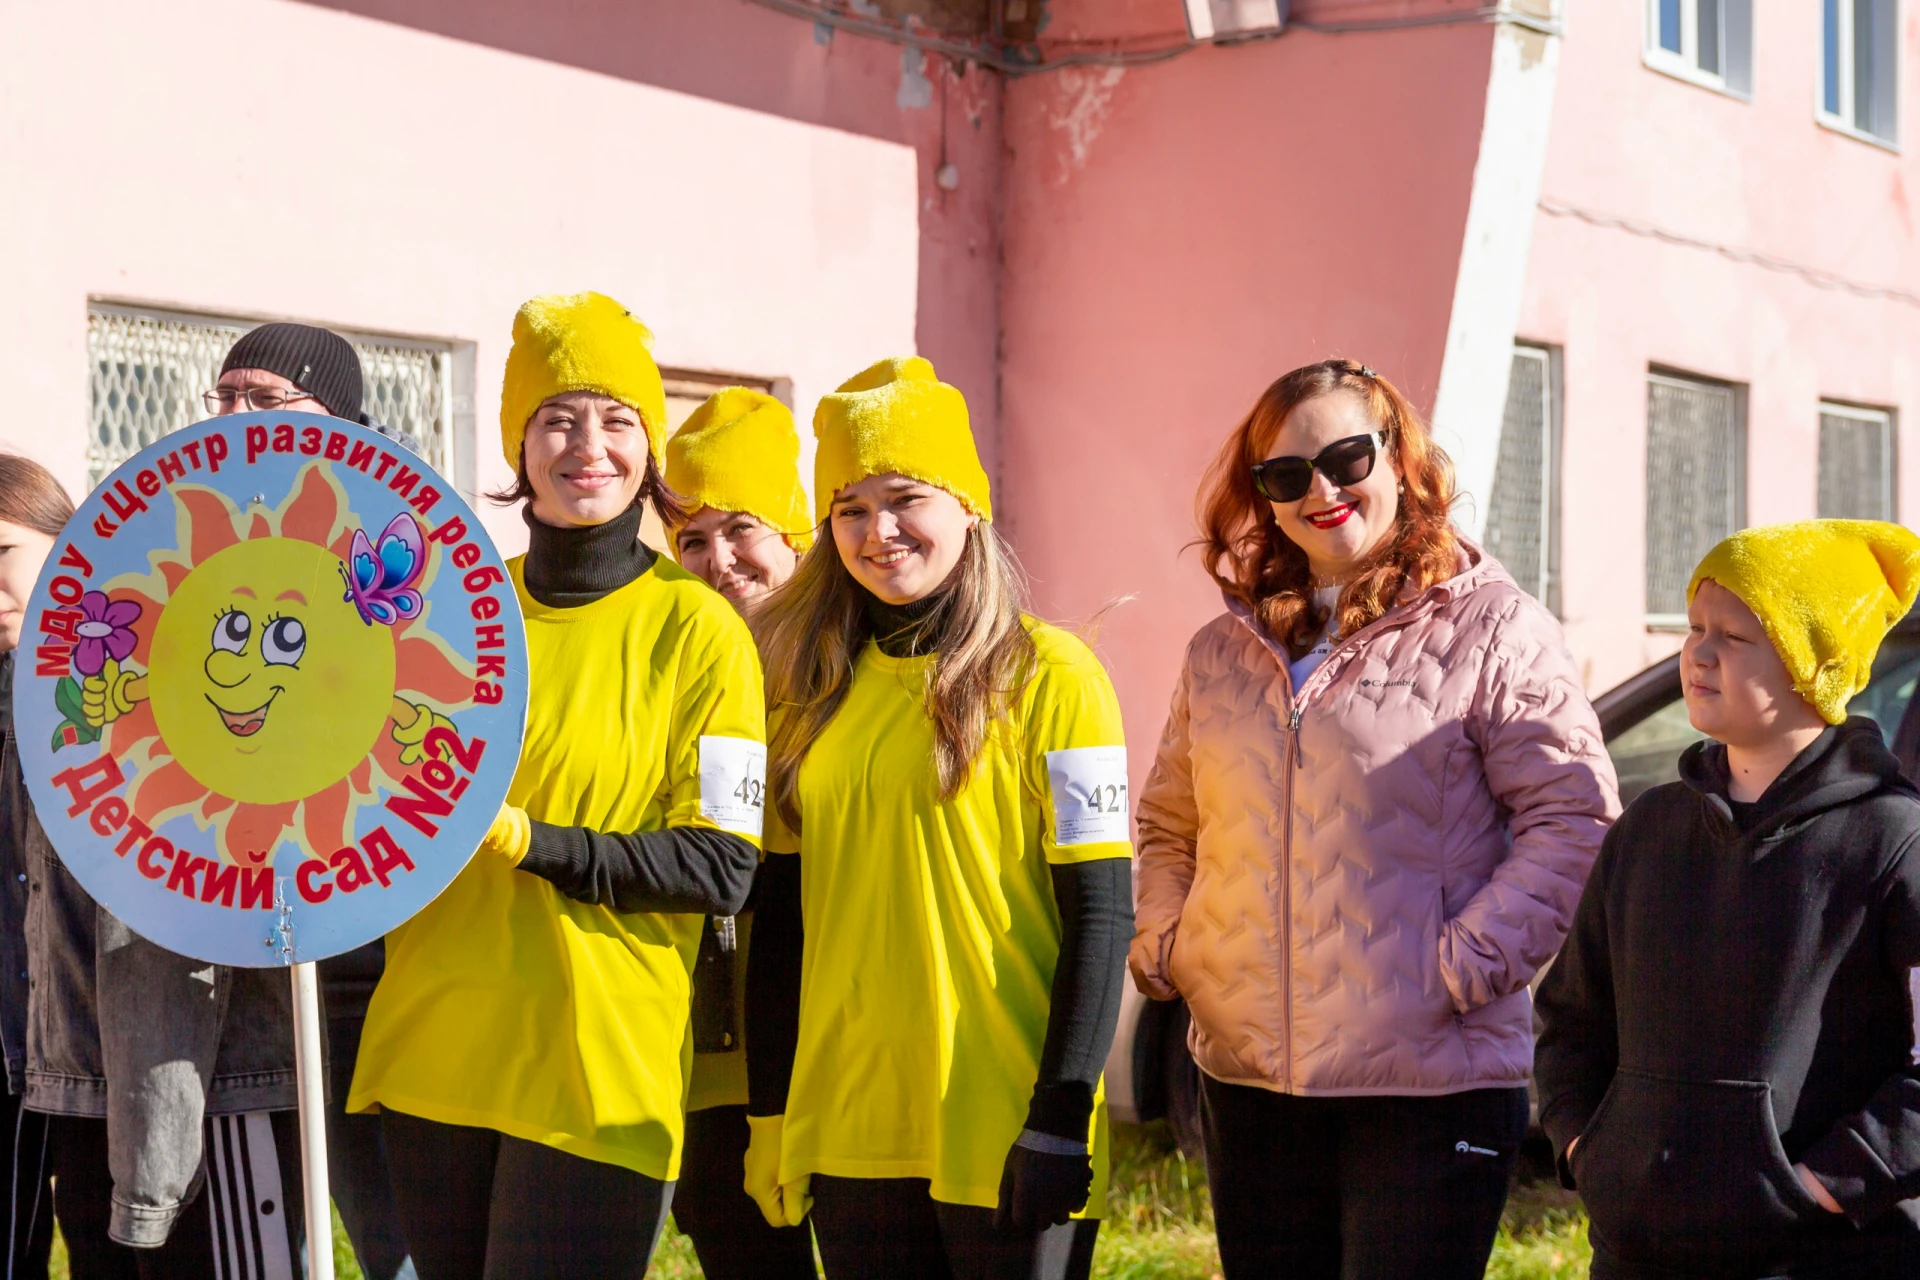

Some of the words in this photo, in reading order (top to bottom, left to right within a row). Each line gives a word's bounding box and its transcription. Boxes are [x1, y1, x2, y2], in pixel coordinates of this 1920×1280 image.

[35, 542, 94, 677] МДОУ
[93, 433, 228, 540] «Центр
[246, 423, 442, 509] развития
[428, 515, 506, 706] ребенка
[51, 752, 275, 910] Детский
[296, 826, 415, 903] сад
[385, 725, 487, 840] №2
[733, 776, 766, 808] 42
[1087, 784, 1127, 813] 427
